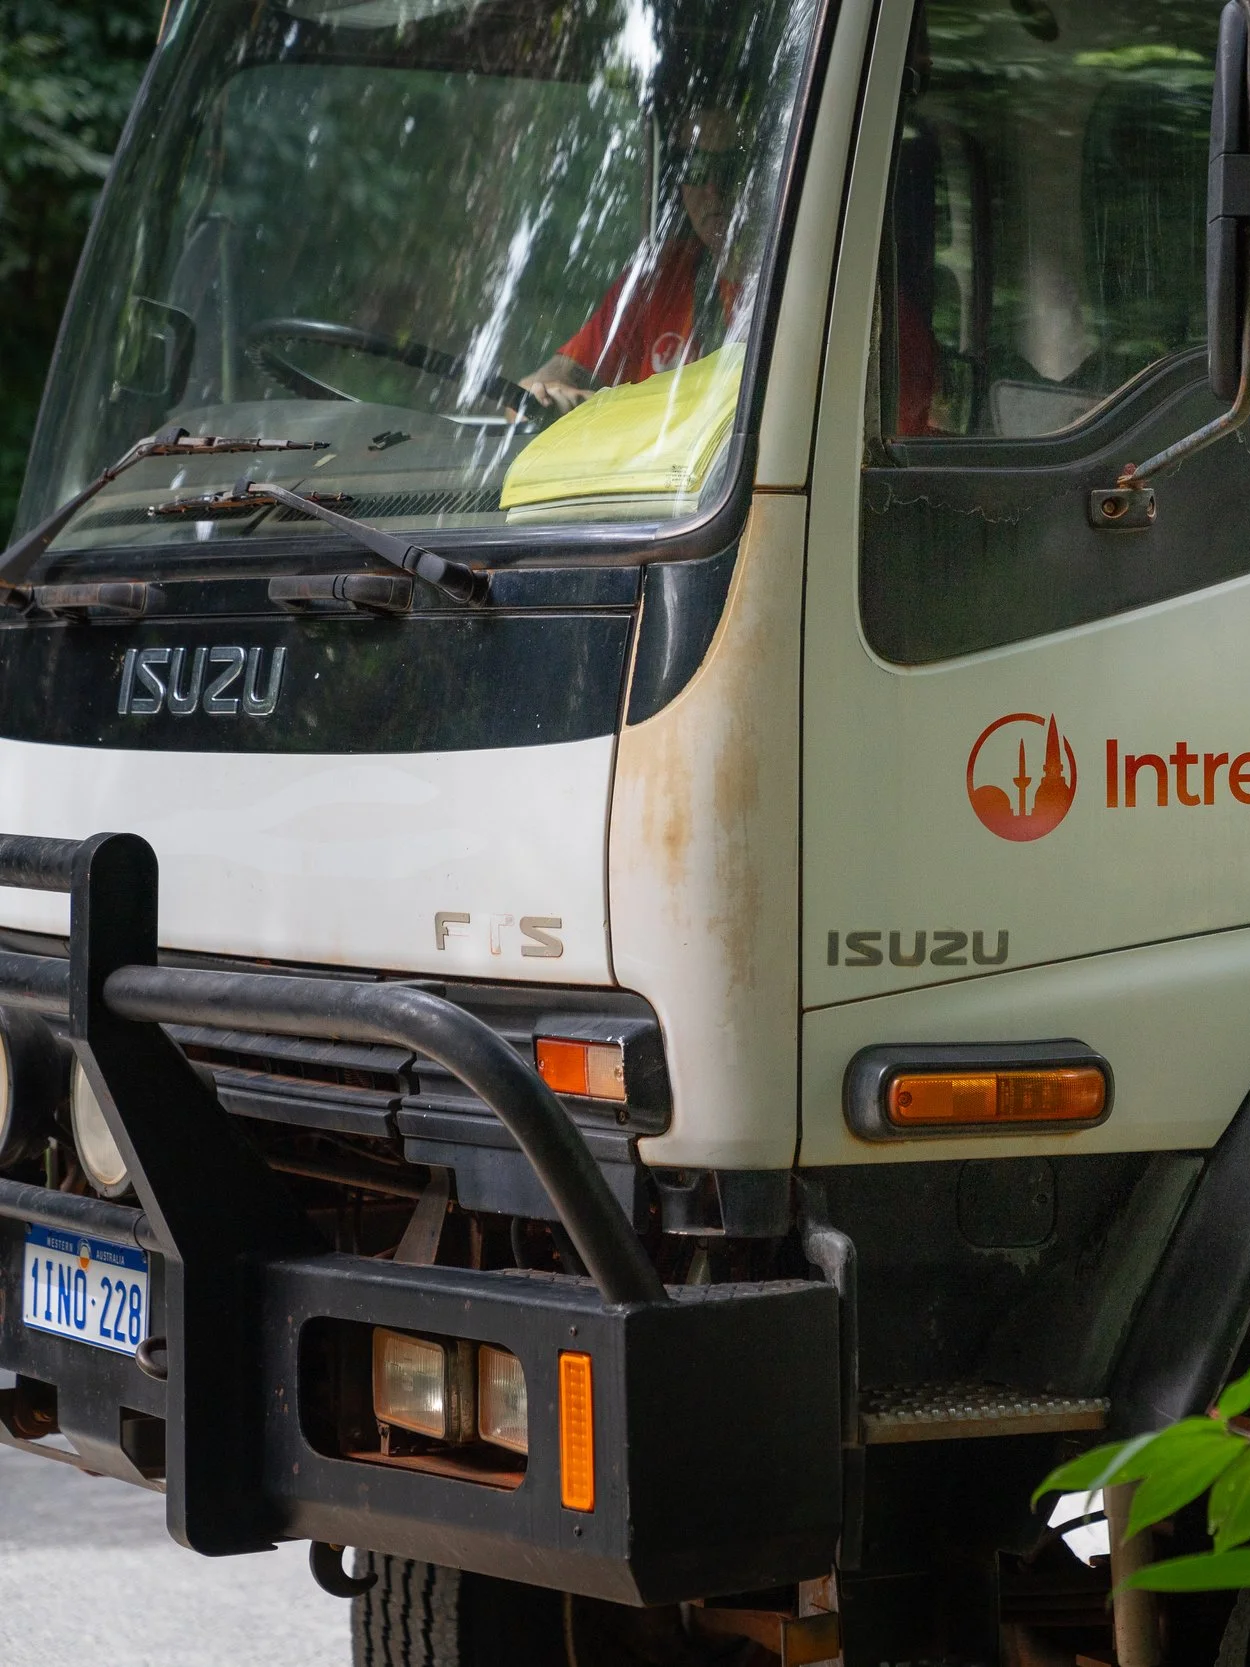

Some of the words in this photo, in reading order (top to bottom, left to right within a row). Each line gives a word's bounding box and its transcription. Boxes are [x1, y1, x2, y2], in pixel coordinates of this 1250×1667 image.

[117, 646, 288, 716] ISUZU
[826, 929, 1009, 967] ISUZU
[46, 1237, 74, 1253] WESTERN
[95, 1249, 125, 1266] AUSTRALIA
